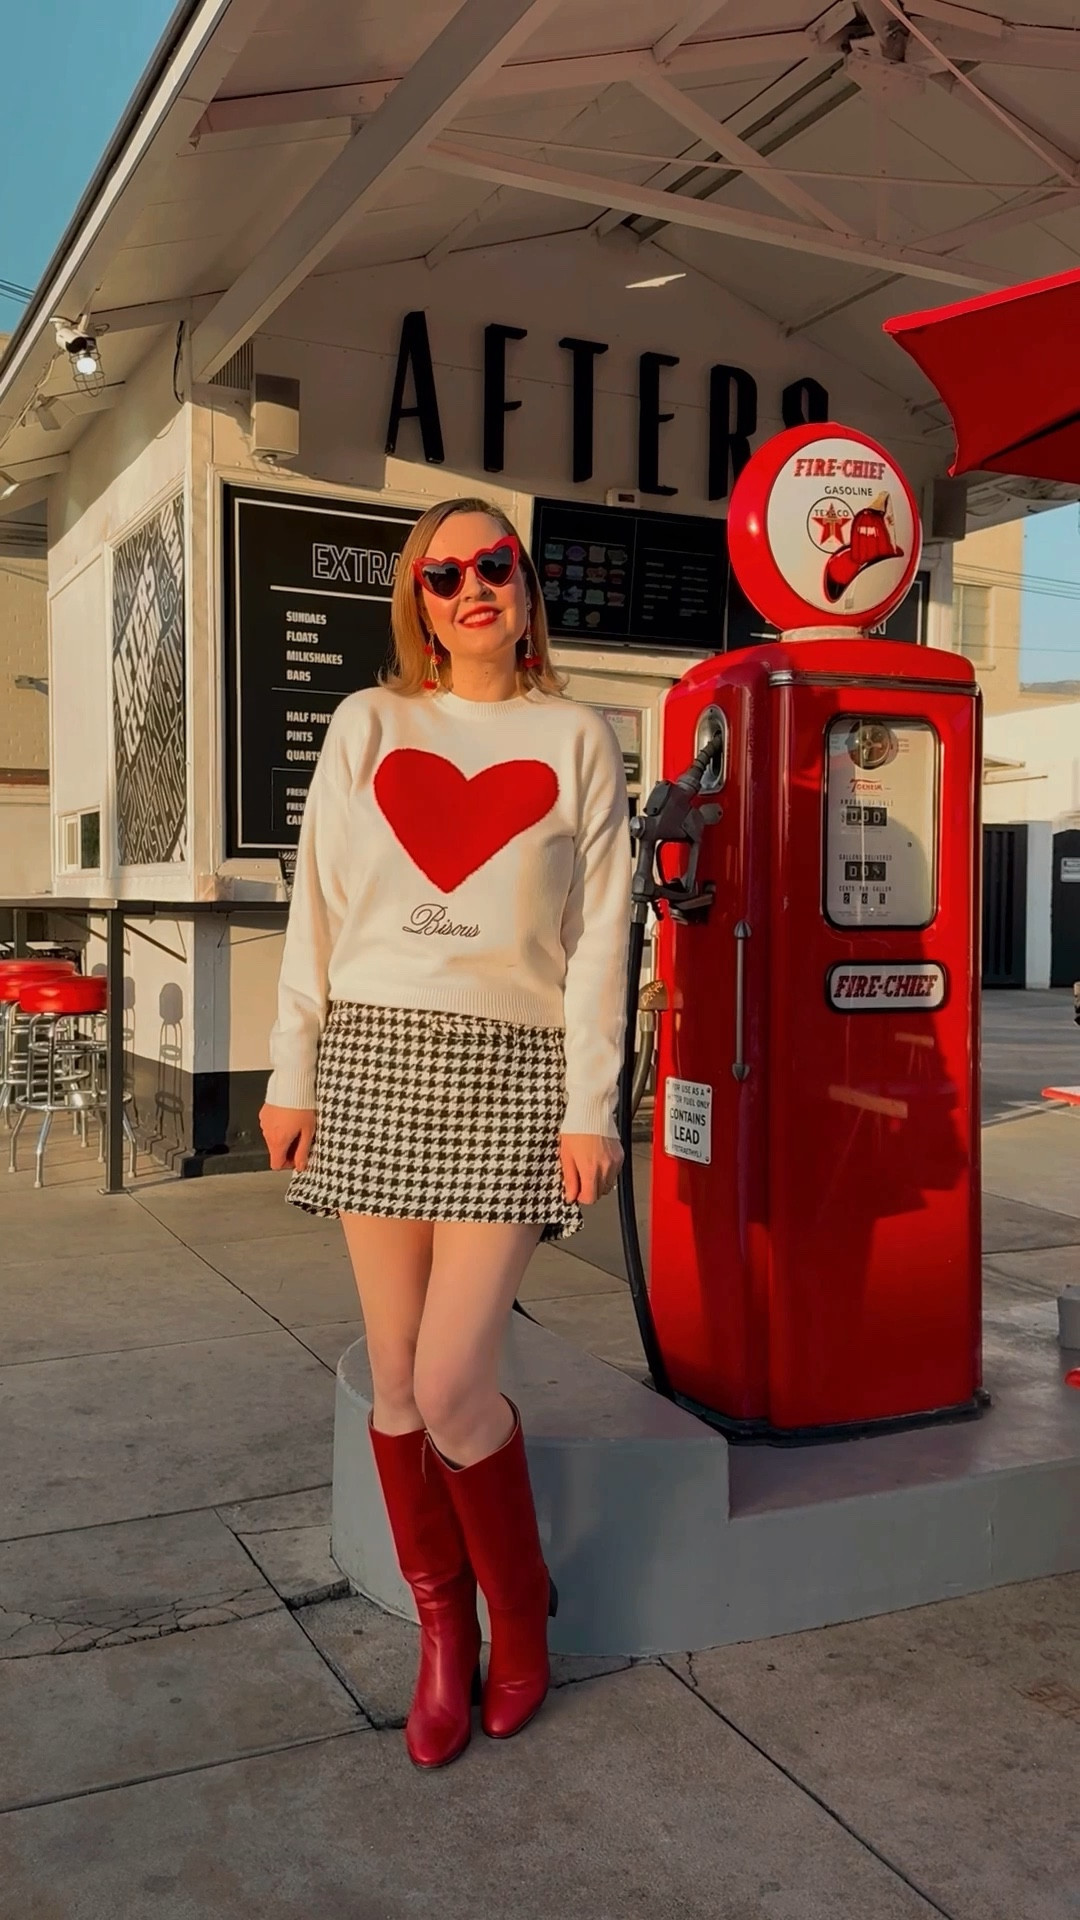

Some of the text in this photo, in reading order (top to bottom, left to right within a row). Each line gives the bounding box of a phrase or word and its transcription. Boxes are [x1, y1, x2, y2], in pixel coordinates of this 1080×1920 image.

[793, 457, 887, 481] FIRE-CHIEF
[824, 485, 873, 497] GASOLINE
[814, 508, 850, 518] TEXACO
[312, 542, 402, 587] EXTRA
[286, 610, 327, 625] SUNDAES
[113, 548, 156, 728] AFTERS
[286, 630, 319, 644] FLOATS
[286, 649, 344, 665] MILKSHAKES
[286, 669, 312, 682] BARS
[286, 710, 333, 724] HALF PINT
[286, 730, 313, 742] PINTS
[286, 802, 306, 811] FRES
[401, 903, 481, 938] Bisous
[833, 974, 939, 998] FIRE-CHIEF
[681, 1085, 692, 1095] USE
[691, 1086, 700, 1096] AS
[700, 1088, 705, 1096] A
[696, 1098, 710, 1110] ONLY
[669, 1107, 706, 1127] CONTAINS
[674, 1124, 700, 1145] LEAD
